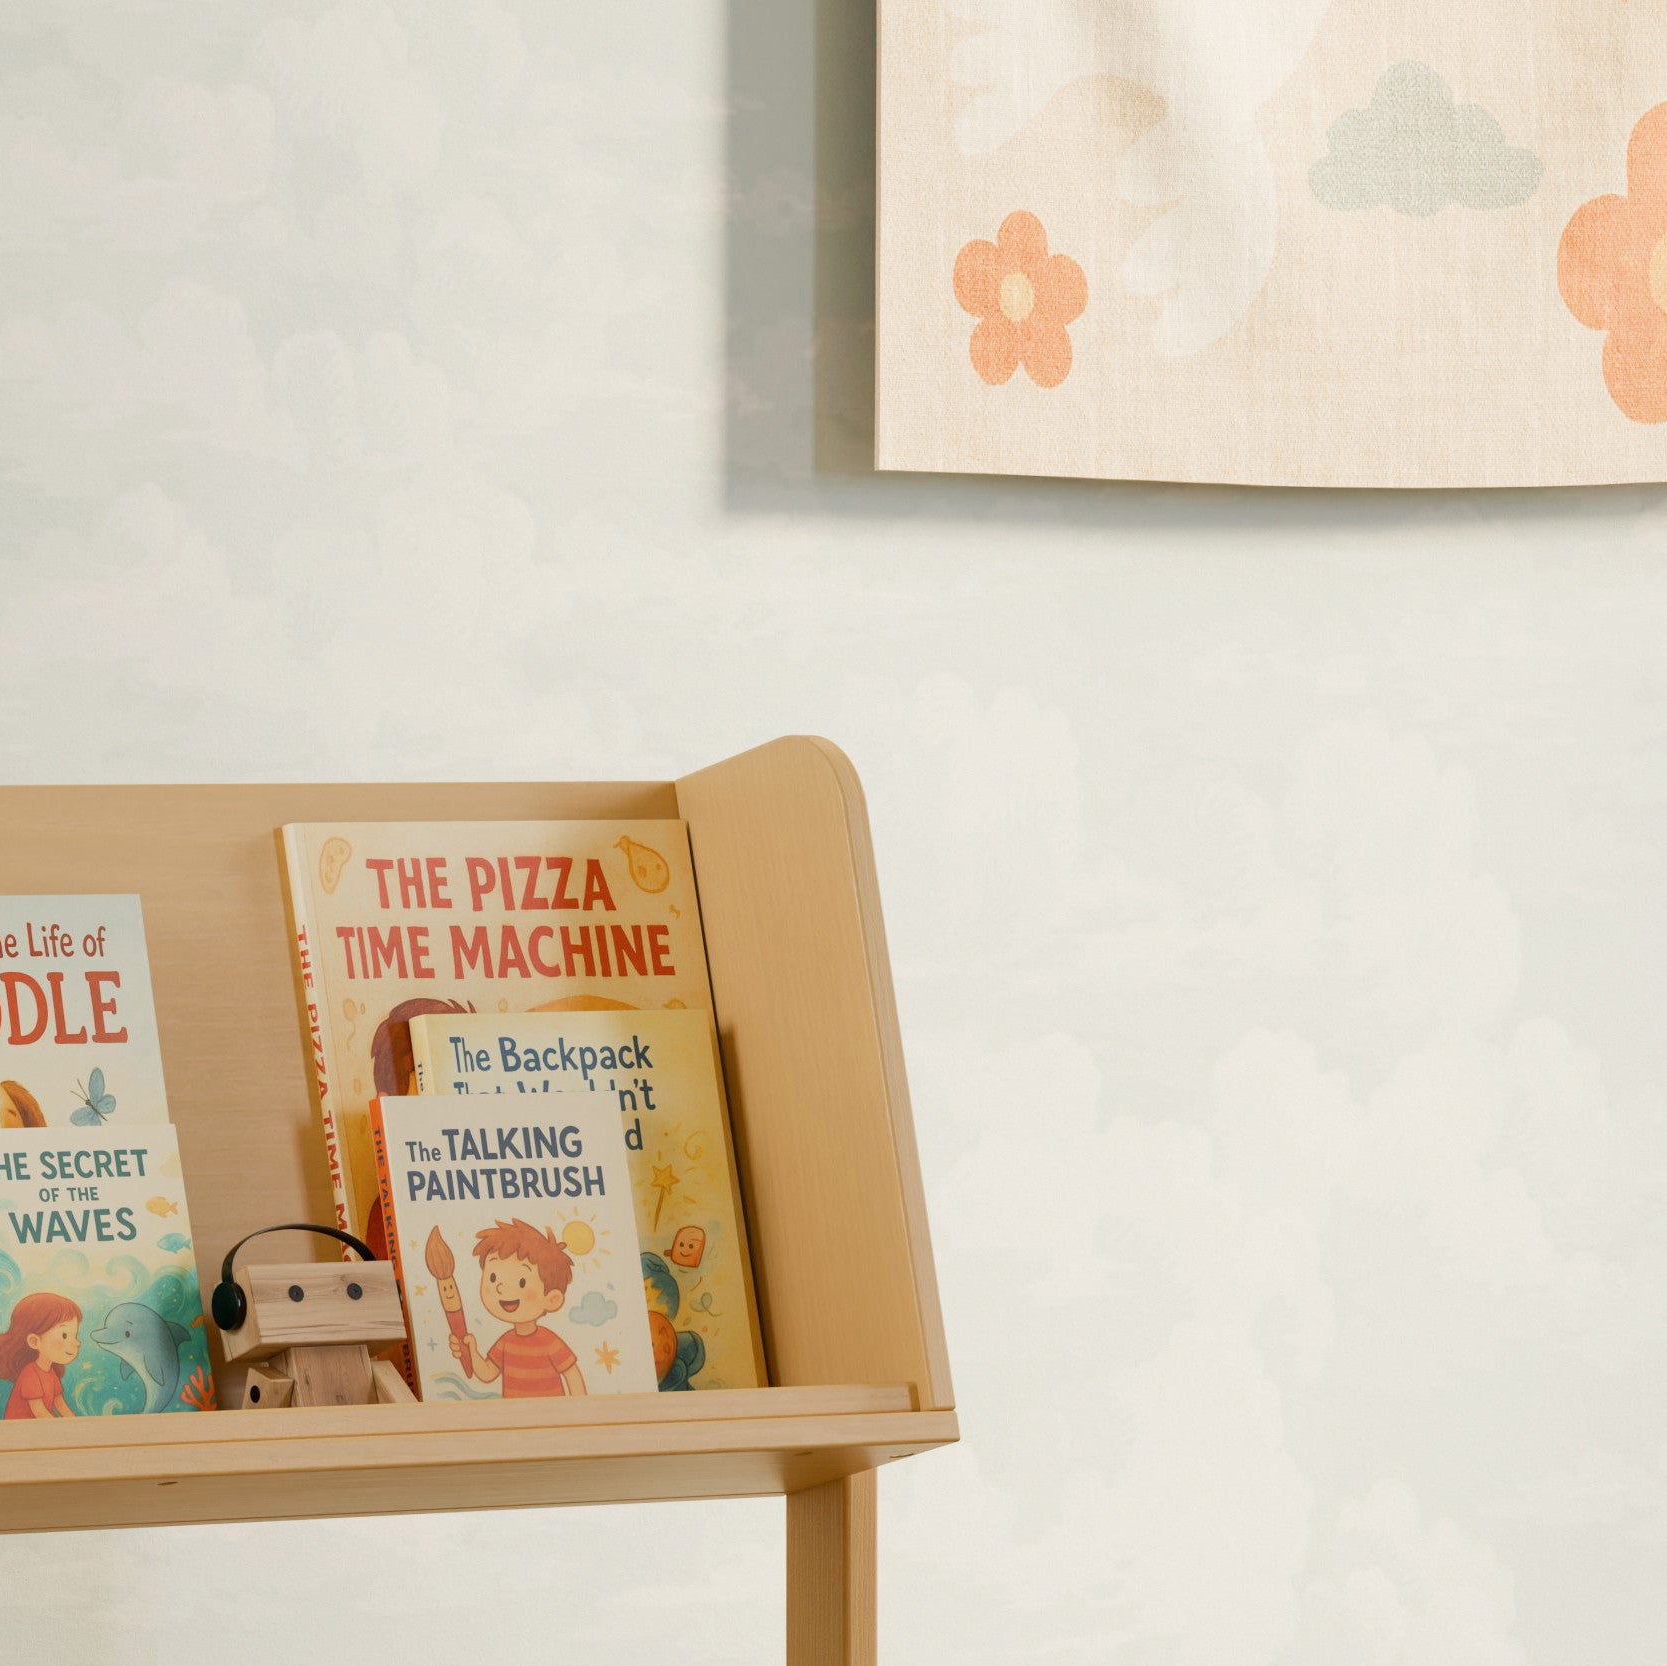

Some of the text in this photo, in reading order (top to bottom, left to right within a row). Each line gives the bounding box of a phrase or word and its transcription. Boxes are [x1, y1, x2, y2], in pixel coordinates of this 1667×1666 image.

[365, 856, 617, 911] THE PIZZA
[26, 922, 76, 958] Life
[83, 926, 107, 958] of
[335, 924, 676, 980] TIME MACHINE
[297, 924, 343, 1189] THE PIZZA TIME
[449, 1035, 653, 1080] The Backpack
[405, 1125, 583, 1162] The TALKING
[39, 1149, 148, 1181] SECRET
[39, 1185, 100, 1204] OF THE
[374, 1129, 397, 1270] THE TALKING
[406, 1166, 606, 1202] PAINTBRUSH
[9, 1207, 138, 1244] WAVES
